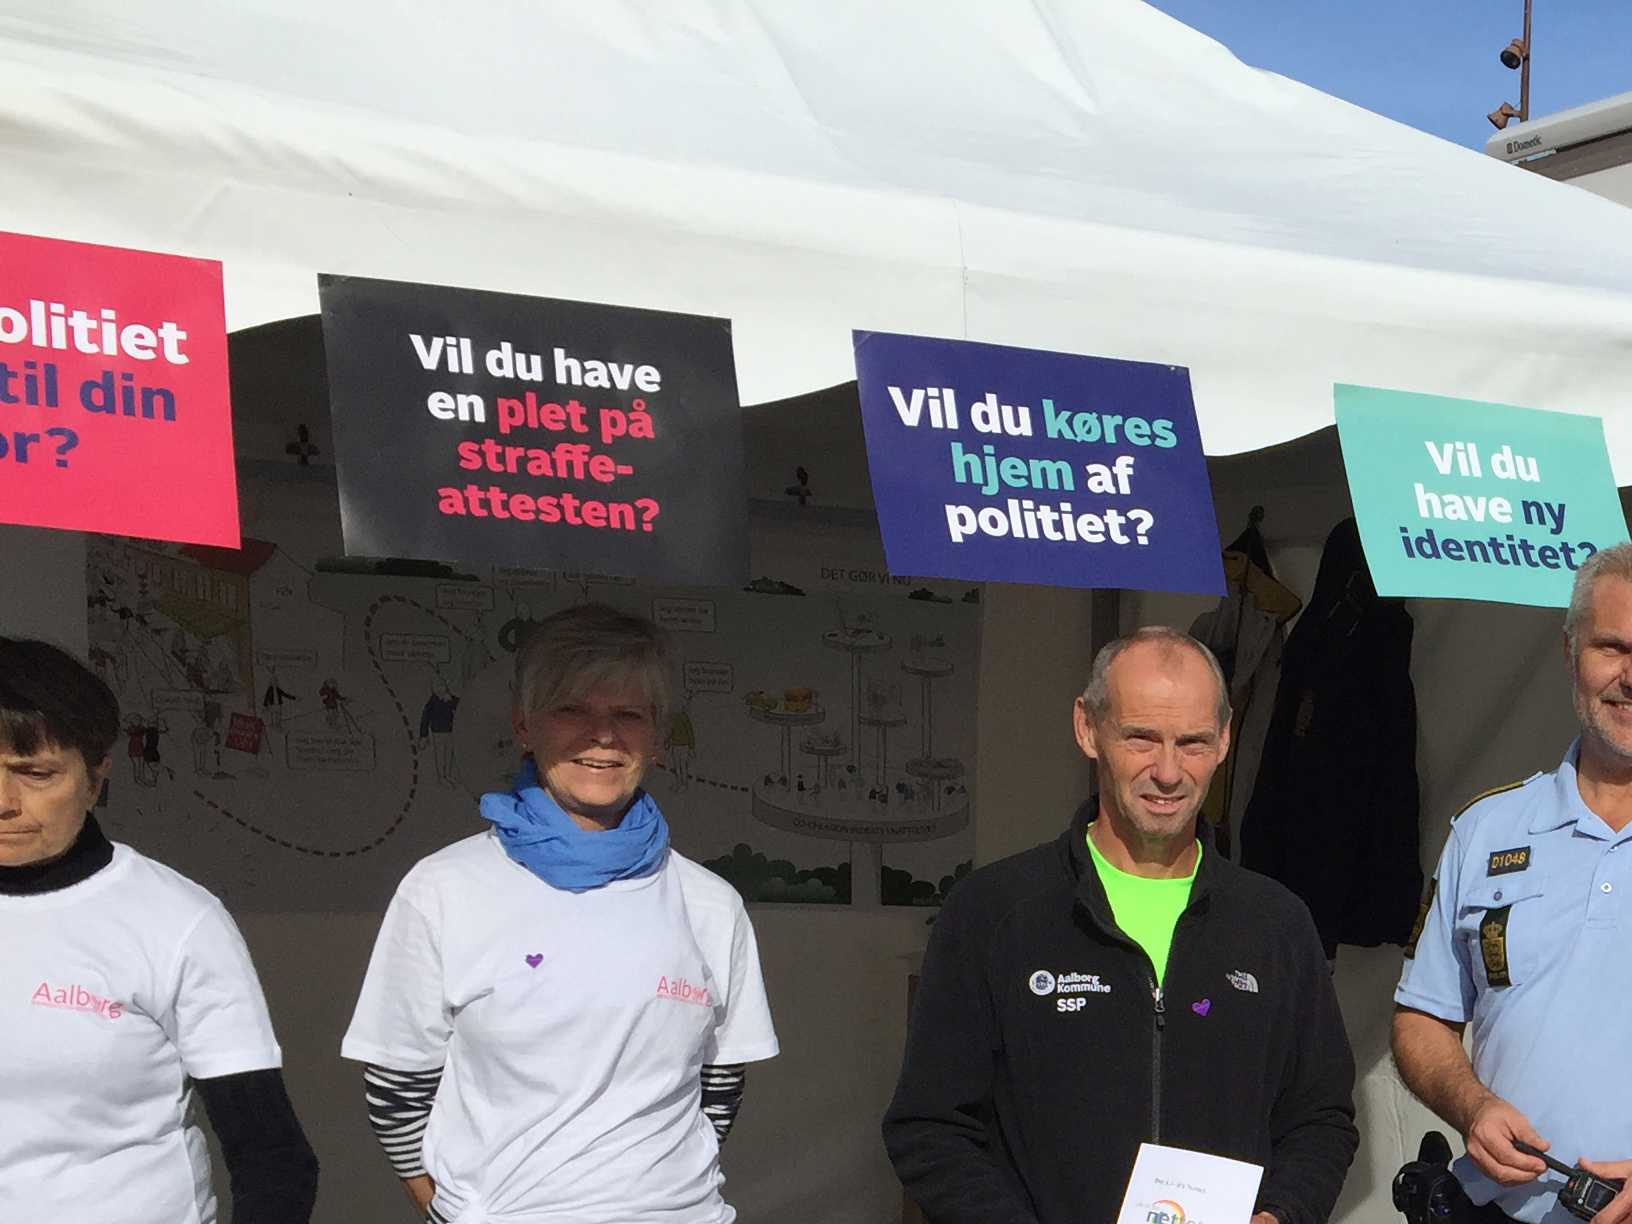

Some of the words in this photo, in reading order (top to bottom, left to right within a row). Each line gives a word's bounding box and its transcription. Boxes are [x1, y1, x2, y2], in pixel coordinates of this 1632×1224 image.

[409, 334, 473, 374] Vil
[485, 341, 543, 382] du
[553, 347, 662, 392] have
[79, 370, 176, 421] din
[427, 390, 486, 423] en
[497, 391, 589, 434] plet
[599, 399, 656, 444] på
[887, 386, 959, 430] Vil
[970, 392, 1033, 437] du
[1041, 399, 1178, 449] køres
[457, 438, 633, 484] straffe-
[951, 442, 1075, 496] hjem
[1085, 455, 1135, 495] af
[1424, 440, 1482, 478] Vil
[1490, 445, 1541, 483] du
[437, 484, 660, 532] attesten?
[945, 498, 1154, 545] politiet?
[1414, 482, 1513, 524] have
[1521, 500, 1566, 535] ny
[1057, 973, 1100, 984] Aalborg
[1057, 983, 1111, 994] Kommune
[1057, 998, 1087, 1012] SSP
